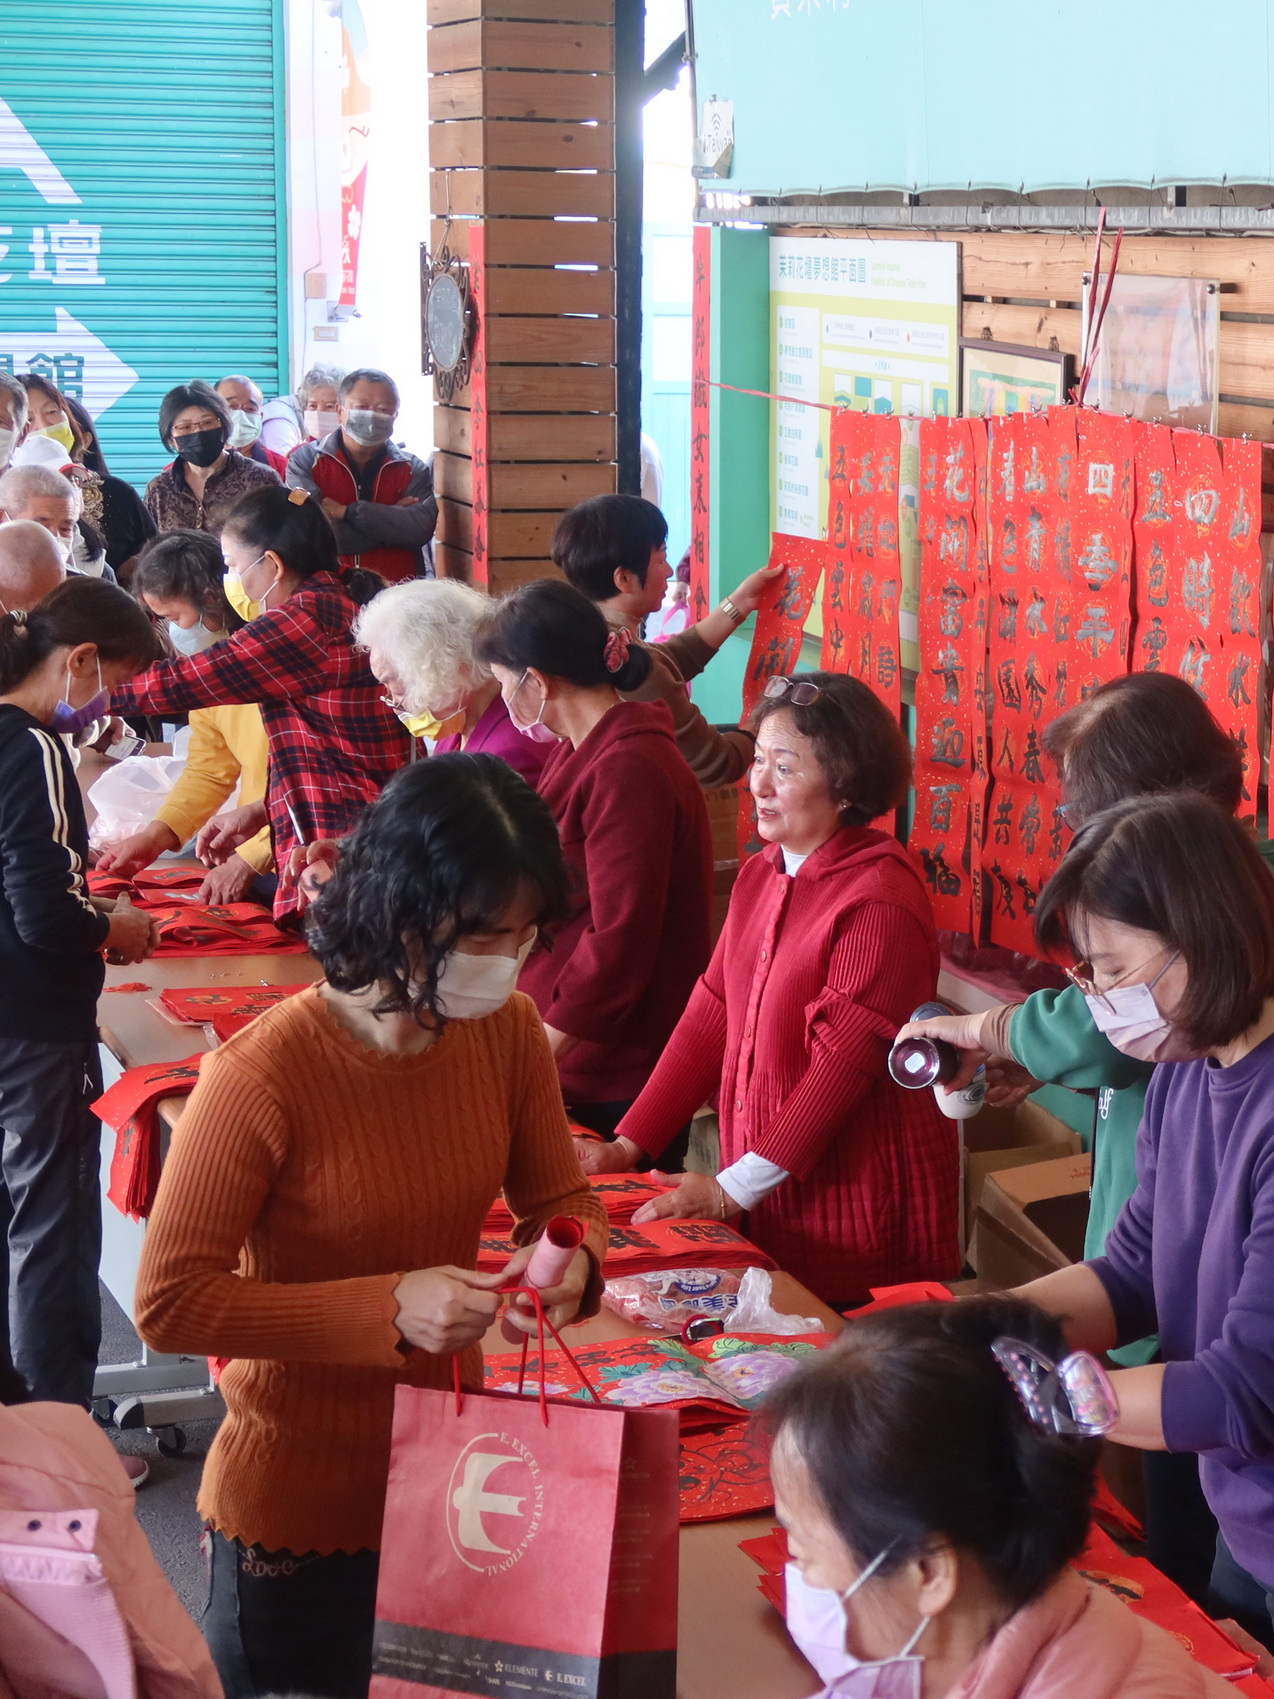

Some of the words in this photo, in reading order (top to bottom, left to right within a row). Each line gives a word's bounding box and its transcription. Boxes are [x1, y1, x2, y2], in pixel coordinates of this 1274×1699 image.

[779, 256, 866, 283] 茉莉花壇夢想館平面圖
[1077, 462, 1120, 695] 四季平
[500, 1431, 510, 1445] E.
[511, 1437, 541, 1480] EXCEL
[484, 1484, 544, 1577] INTERNATIONAL
[504, 1664, 539, 1677] ELEMENTE
